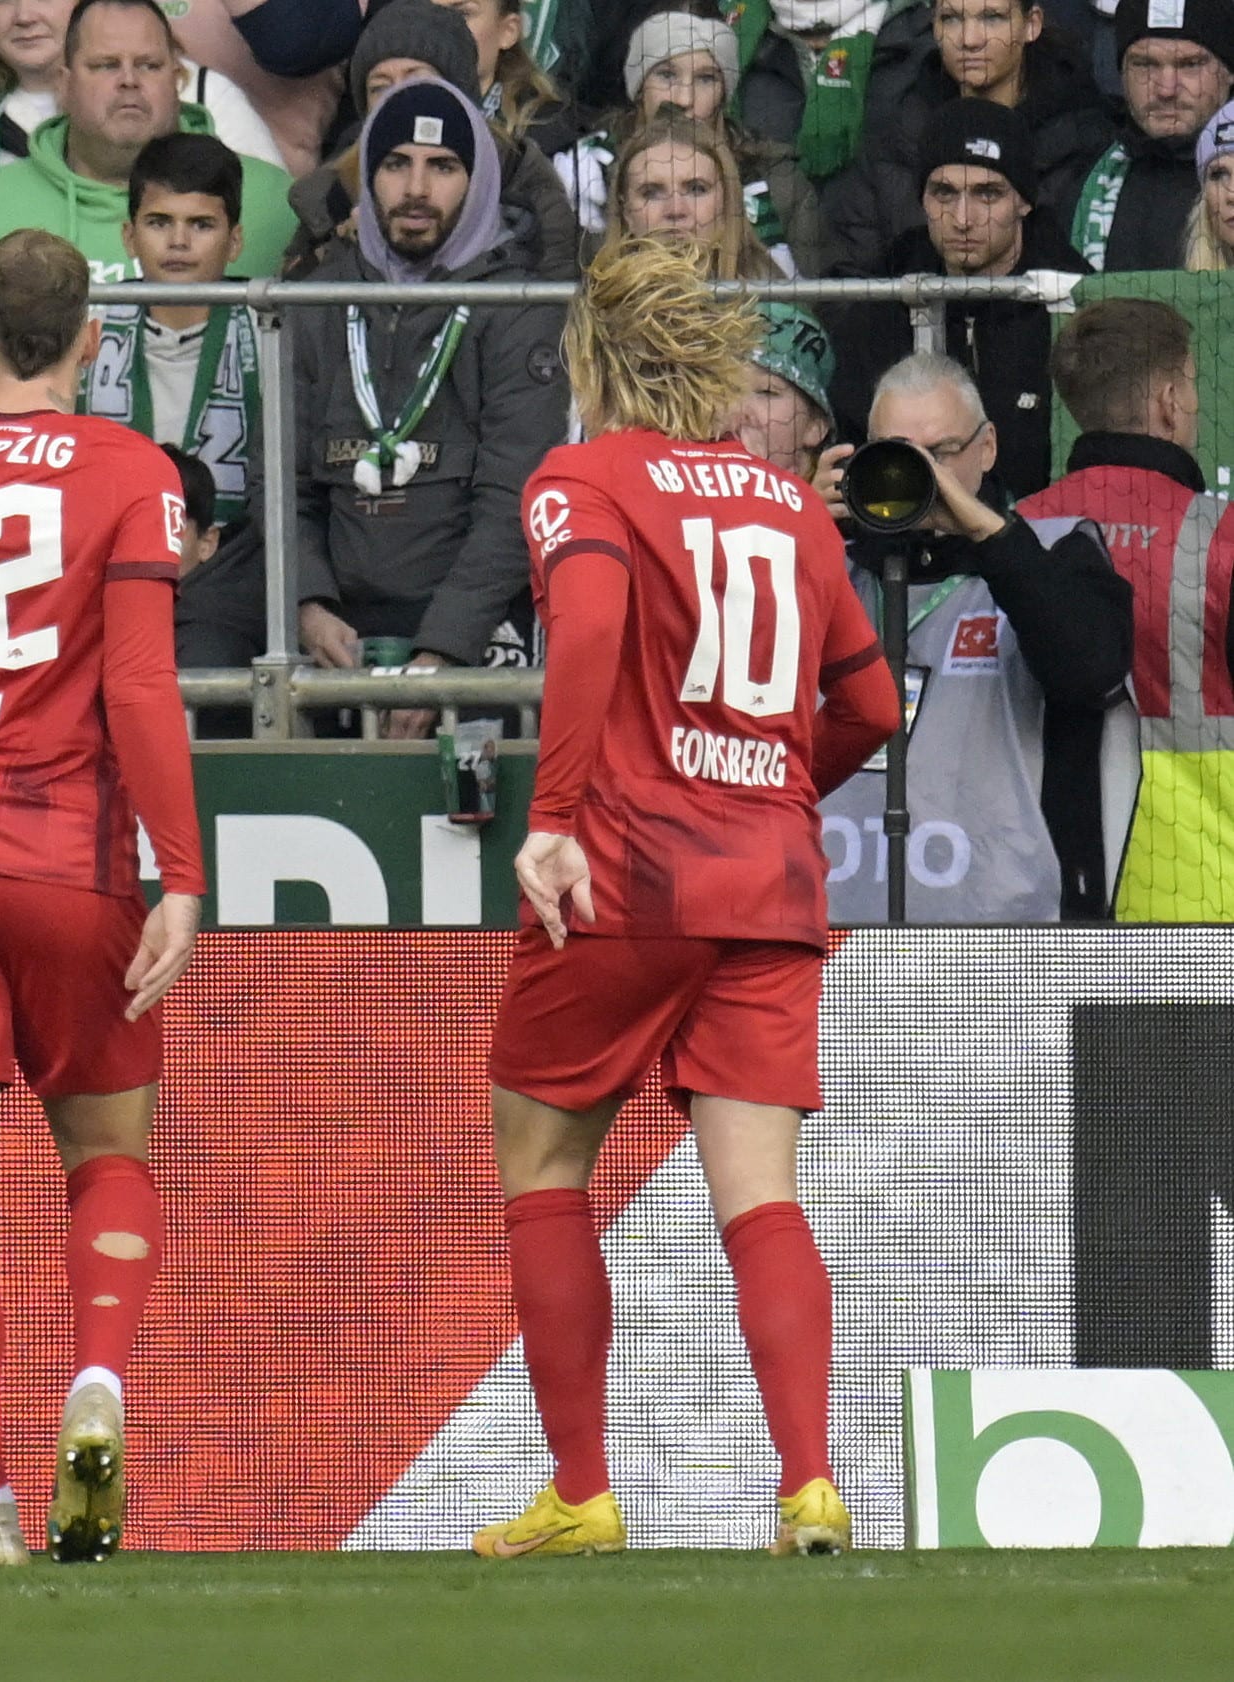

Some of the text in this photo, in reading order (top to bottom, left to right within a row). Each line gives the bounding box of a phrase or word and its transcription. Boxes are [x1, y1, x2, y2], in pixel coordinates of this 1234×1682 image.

[646, 459, 803, 512] RB LEIPZIG
[680, 517, 800, 717] 10
[671, 726, 787, 787] FORSBERG
